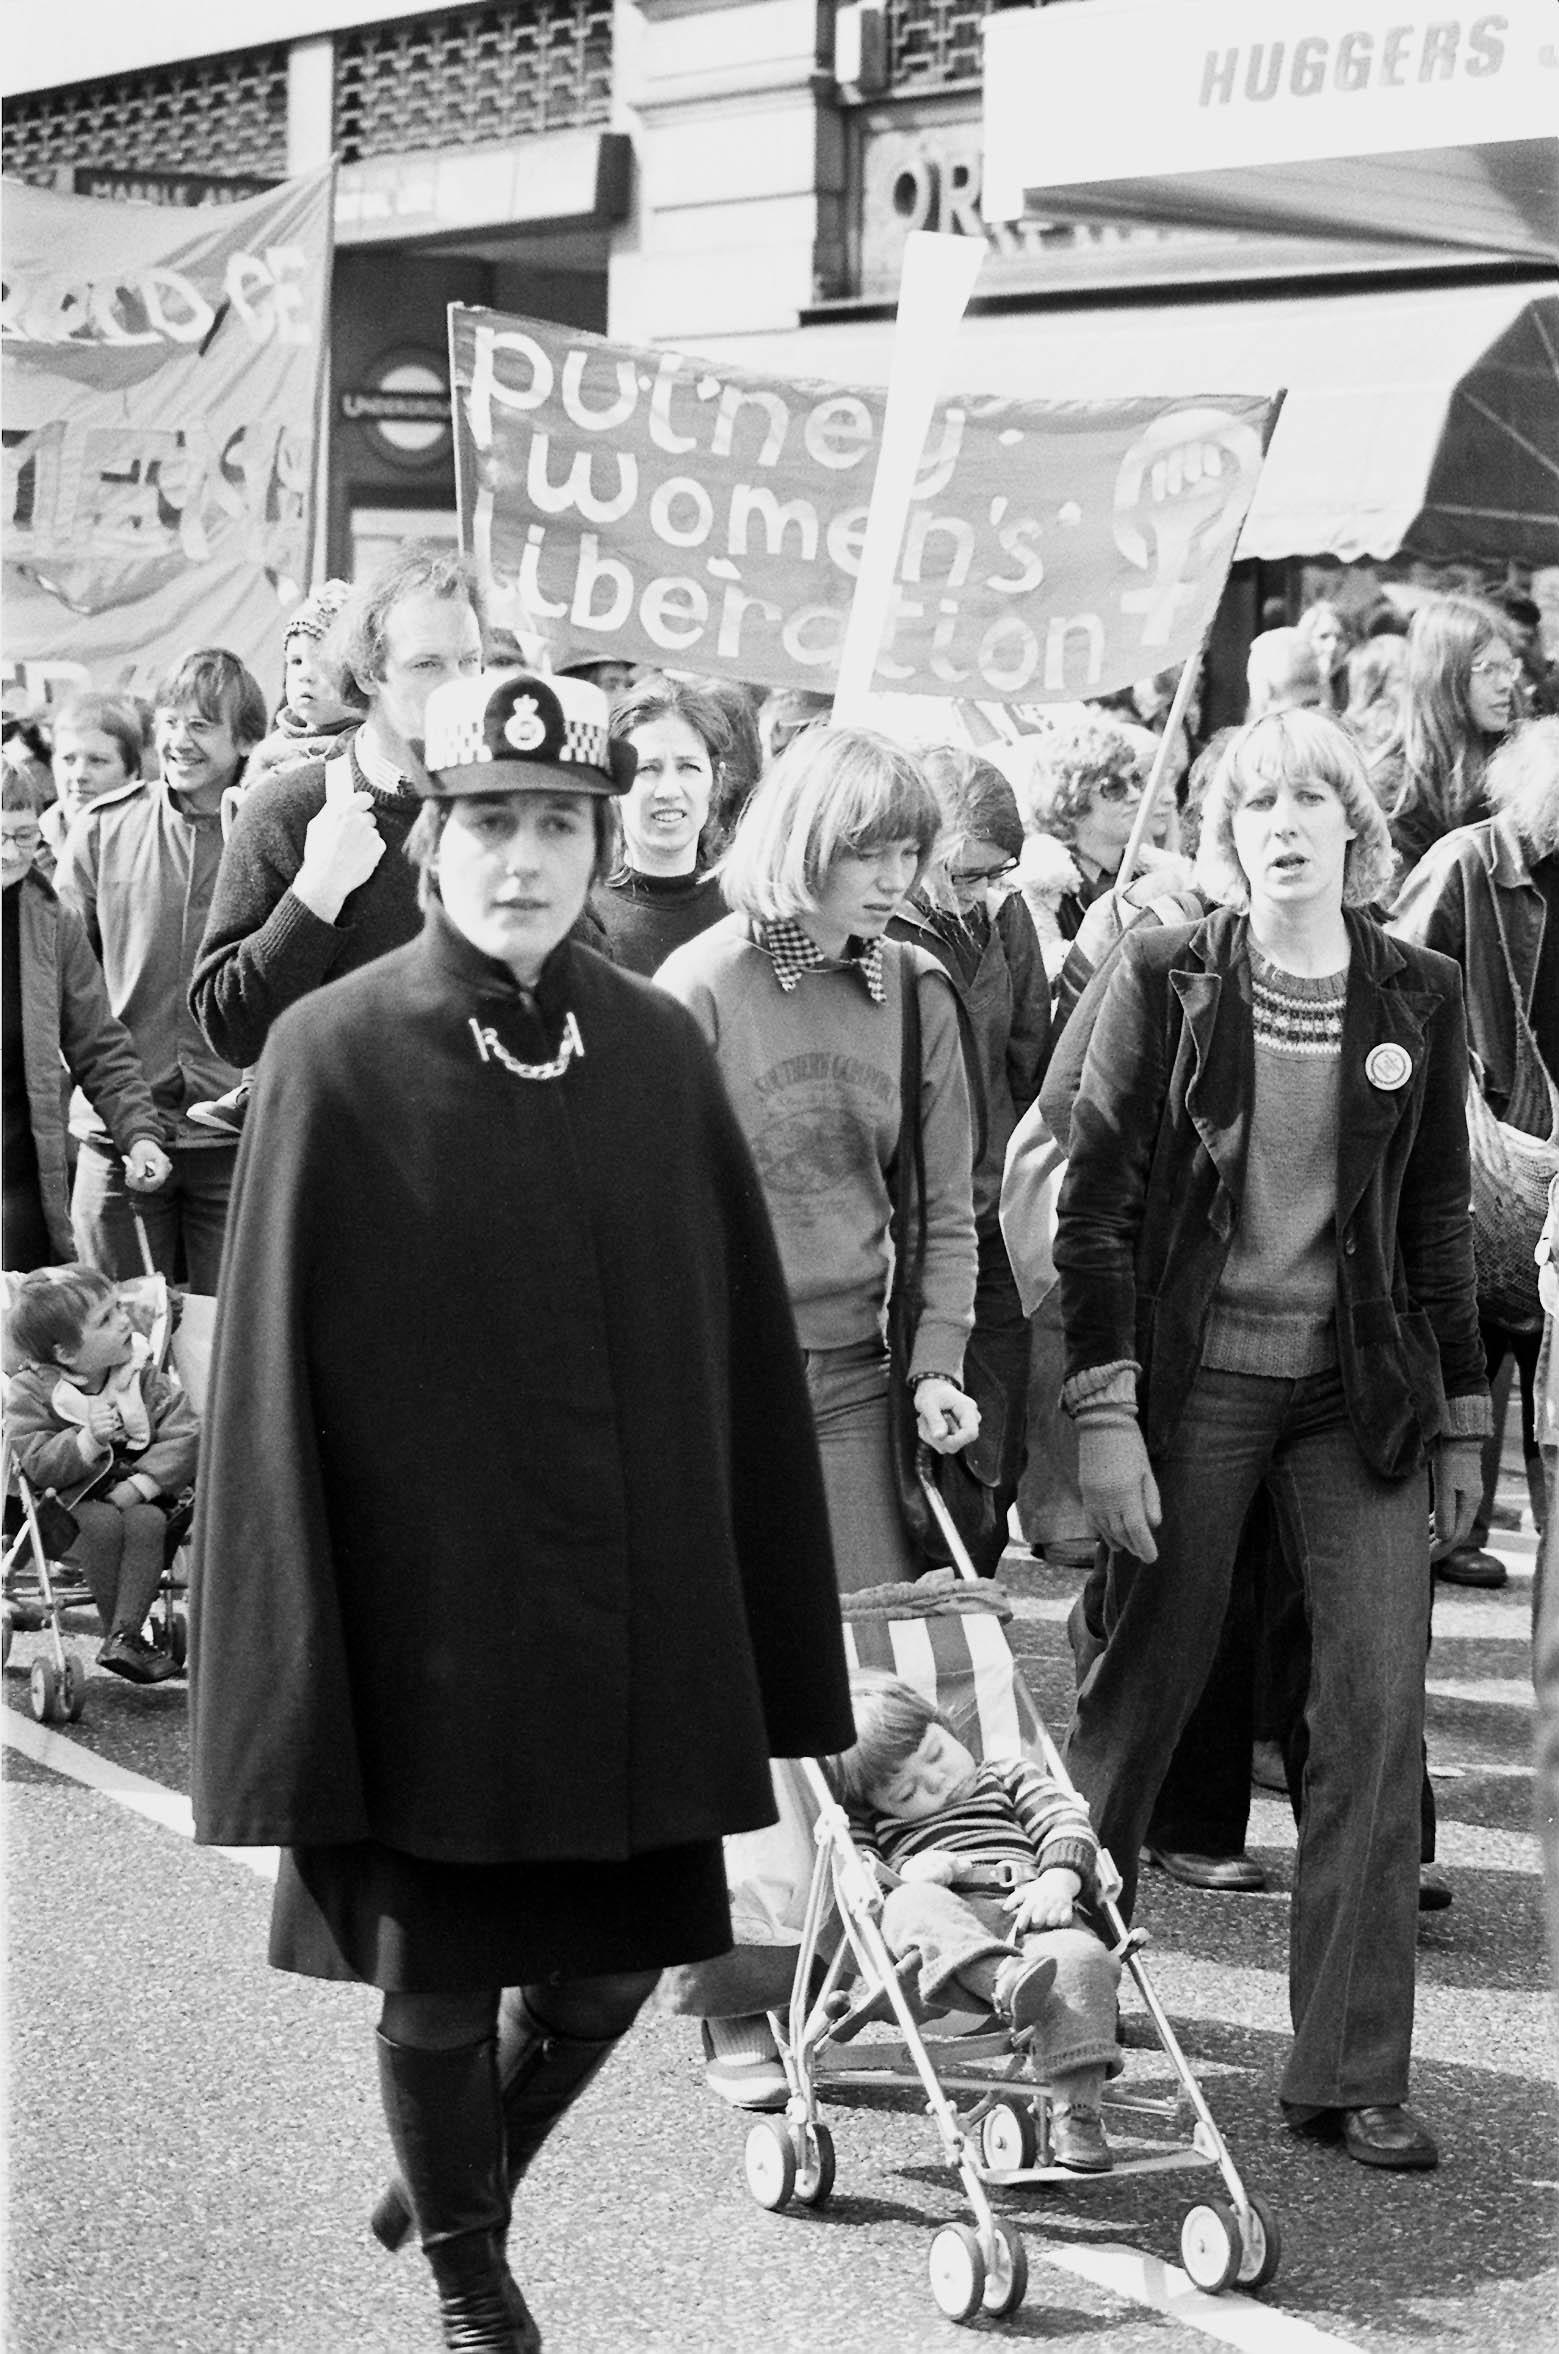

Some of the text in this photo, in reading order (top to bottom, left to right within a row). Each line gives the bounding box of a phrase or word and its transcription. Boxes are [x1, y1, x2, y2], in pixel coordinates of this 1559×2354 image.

[1198, 14, 1510, 107] HUGGERS
[203, 186, 252, 206] ARC
[527, 432, 1044, 593] women's
[474, 490, 1106, 692] liberation
